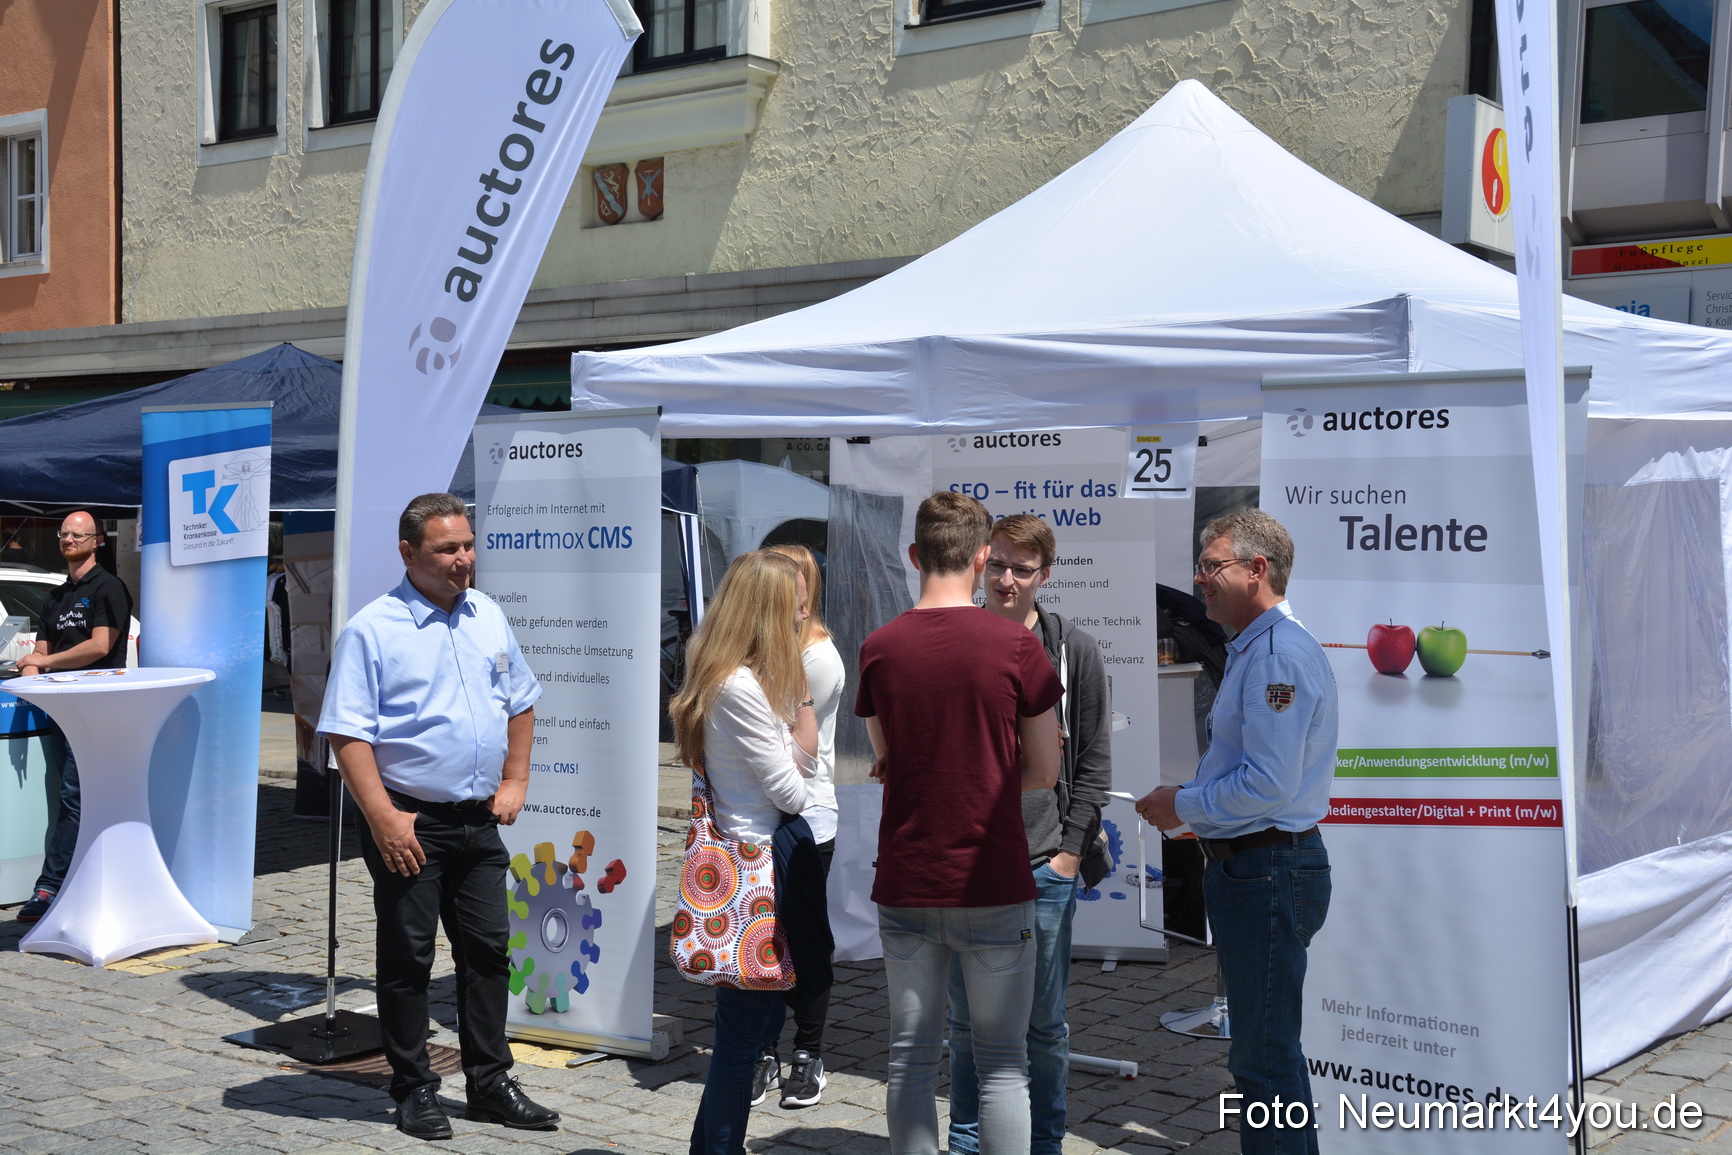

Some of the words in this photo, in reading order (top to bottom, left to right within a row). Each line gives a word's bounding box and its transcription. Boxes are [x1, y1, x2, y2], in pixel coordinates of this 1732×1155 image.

[445, 39, 574, 302] auctores
[1619, 244, 1704, 257] Fußpflege
[1613, 261, 1660, 271] Michael
[1667, 257, 1709, 267] Künzel
[1705, 317, 1712, 327] &
[1323, 406, 1450, 431] auctores
[797, 442, 813, 451] CO.
[973, 432, 1062, 448] auctores
[509, 441, 583, 460] auctores
[1134, 448, 1172, 483] 25
[1014, 481, 1036, 499] fit
[1043, 480, 1073, 498] für
[1081, 479, 1117, 497] das
[1285, 486, 1323, 504] Wir
[1330, 484, 1406, 504] suchen
[182, 469, 240, 534] TK
[488, 504, 533, 517] Erfolgreich
[537, 504, 548, 514] im
[550, 504, 588, 514] Internet
[590, 502, 605, 514] mit
[1053, 508, 1102, 526] Web
[183, 522, 207, 531] Techniker
[1339, 513, 1488, 552] Talente
[183, 530, 217, 540] Krankenkasse
[487, 529, 584, 550] smartmox
[588, 525, 632, 548] CMS
[183, 541, 202, 550] Gesund
[1052, 556, 1093, 566] efunden
[1040, 579, 1087, 589] aschinen
[1090, 579, 1108, 588] und
[498, 592, 528, 603] wollen
[507, 617, 527, 627] Web
[529, 616, 573, 629] gefunden
[576, 619, 608, 628] werden
[1102, 617, 1141, 626] Technik
[532, 644, 582, 655] technische
[584, 646, 633, 659] Umsetzung
[1098, 640, 1112, 649] für
[535, 672, 552, 682] und
[554, 672, 610, 684] individuelles
[533, 716, 556, 727] hnell
[559, 718, 577, 729] und
[580, 719, 611, 730] einfach
[553, 762, 579, 774] CMS!
[1336, 754, 1507, 769] ker/Anwendungsentwicklung
[1509, 754, 1549, 769] (m/w)
[523, 803, 601, 818] ww.auctores.de
[1479, 805, 1511, 818] Print
[1515, 805, 1557, 820] (m/w)
[1322, 998, 1361, 1017] Mehr
[1366, 1005, 1480, 1037] Informationen
[1341, 1025, 1408, 1049] jederzeit
[1413, 1040, 1456, 1058] unter
[1306, 1057, 1518, 1112] ww.auctoresde
